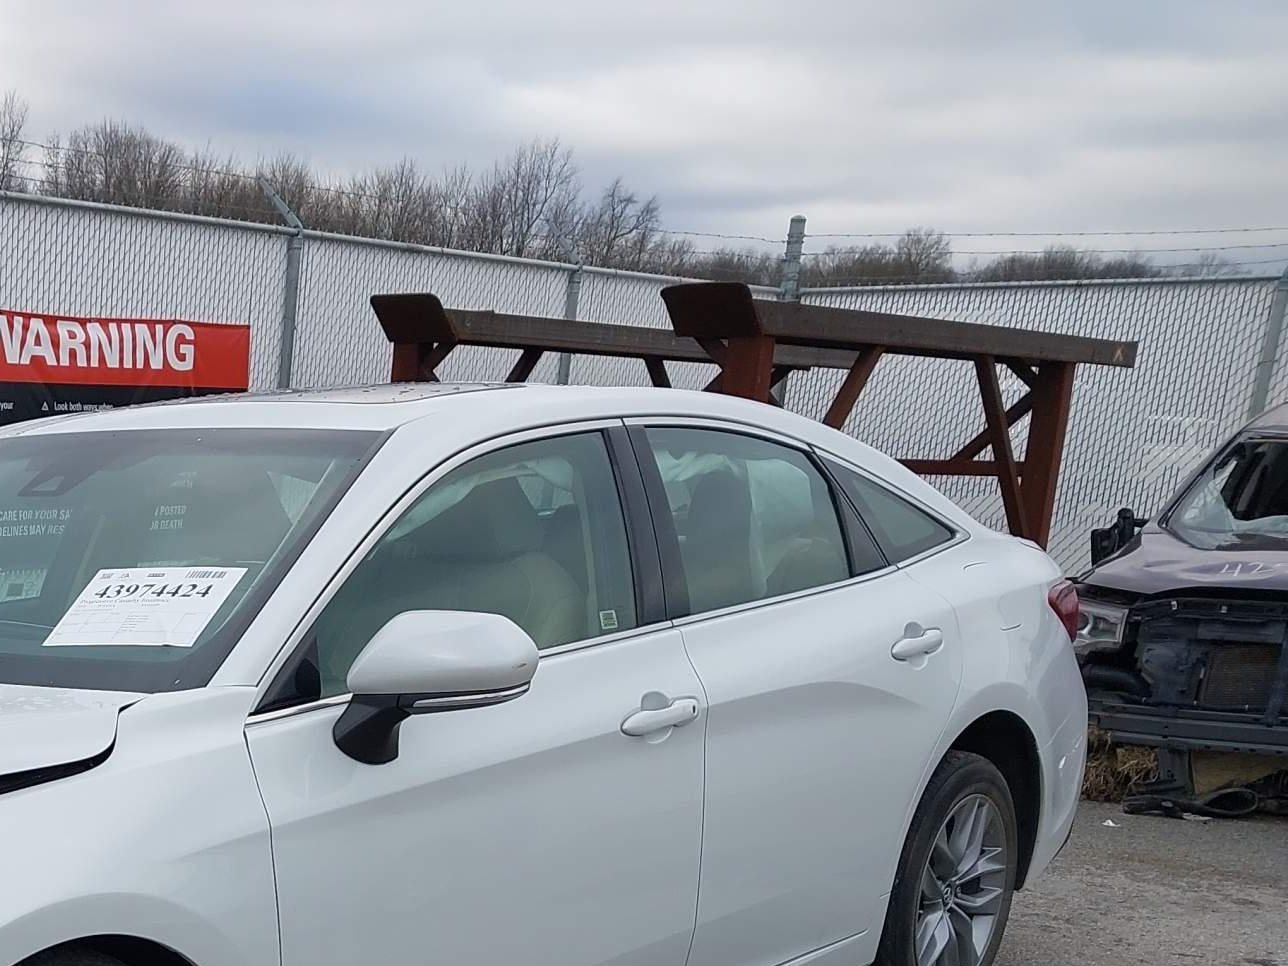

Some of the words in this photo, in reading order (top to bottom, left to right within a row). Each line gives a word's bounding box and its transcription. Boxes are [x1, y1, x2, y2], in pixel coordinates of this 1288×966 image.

[0, 402, 14, 411] your
[54, 401, 67, 411] Look
[69, 401, 82, 411] both
[18, 510, 33, 520] FOR
[34, 509, 58, 520] YOUR
[29, 524, 46, 536] MAY
[94, 583, 214, 599] 43974424
